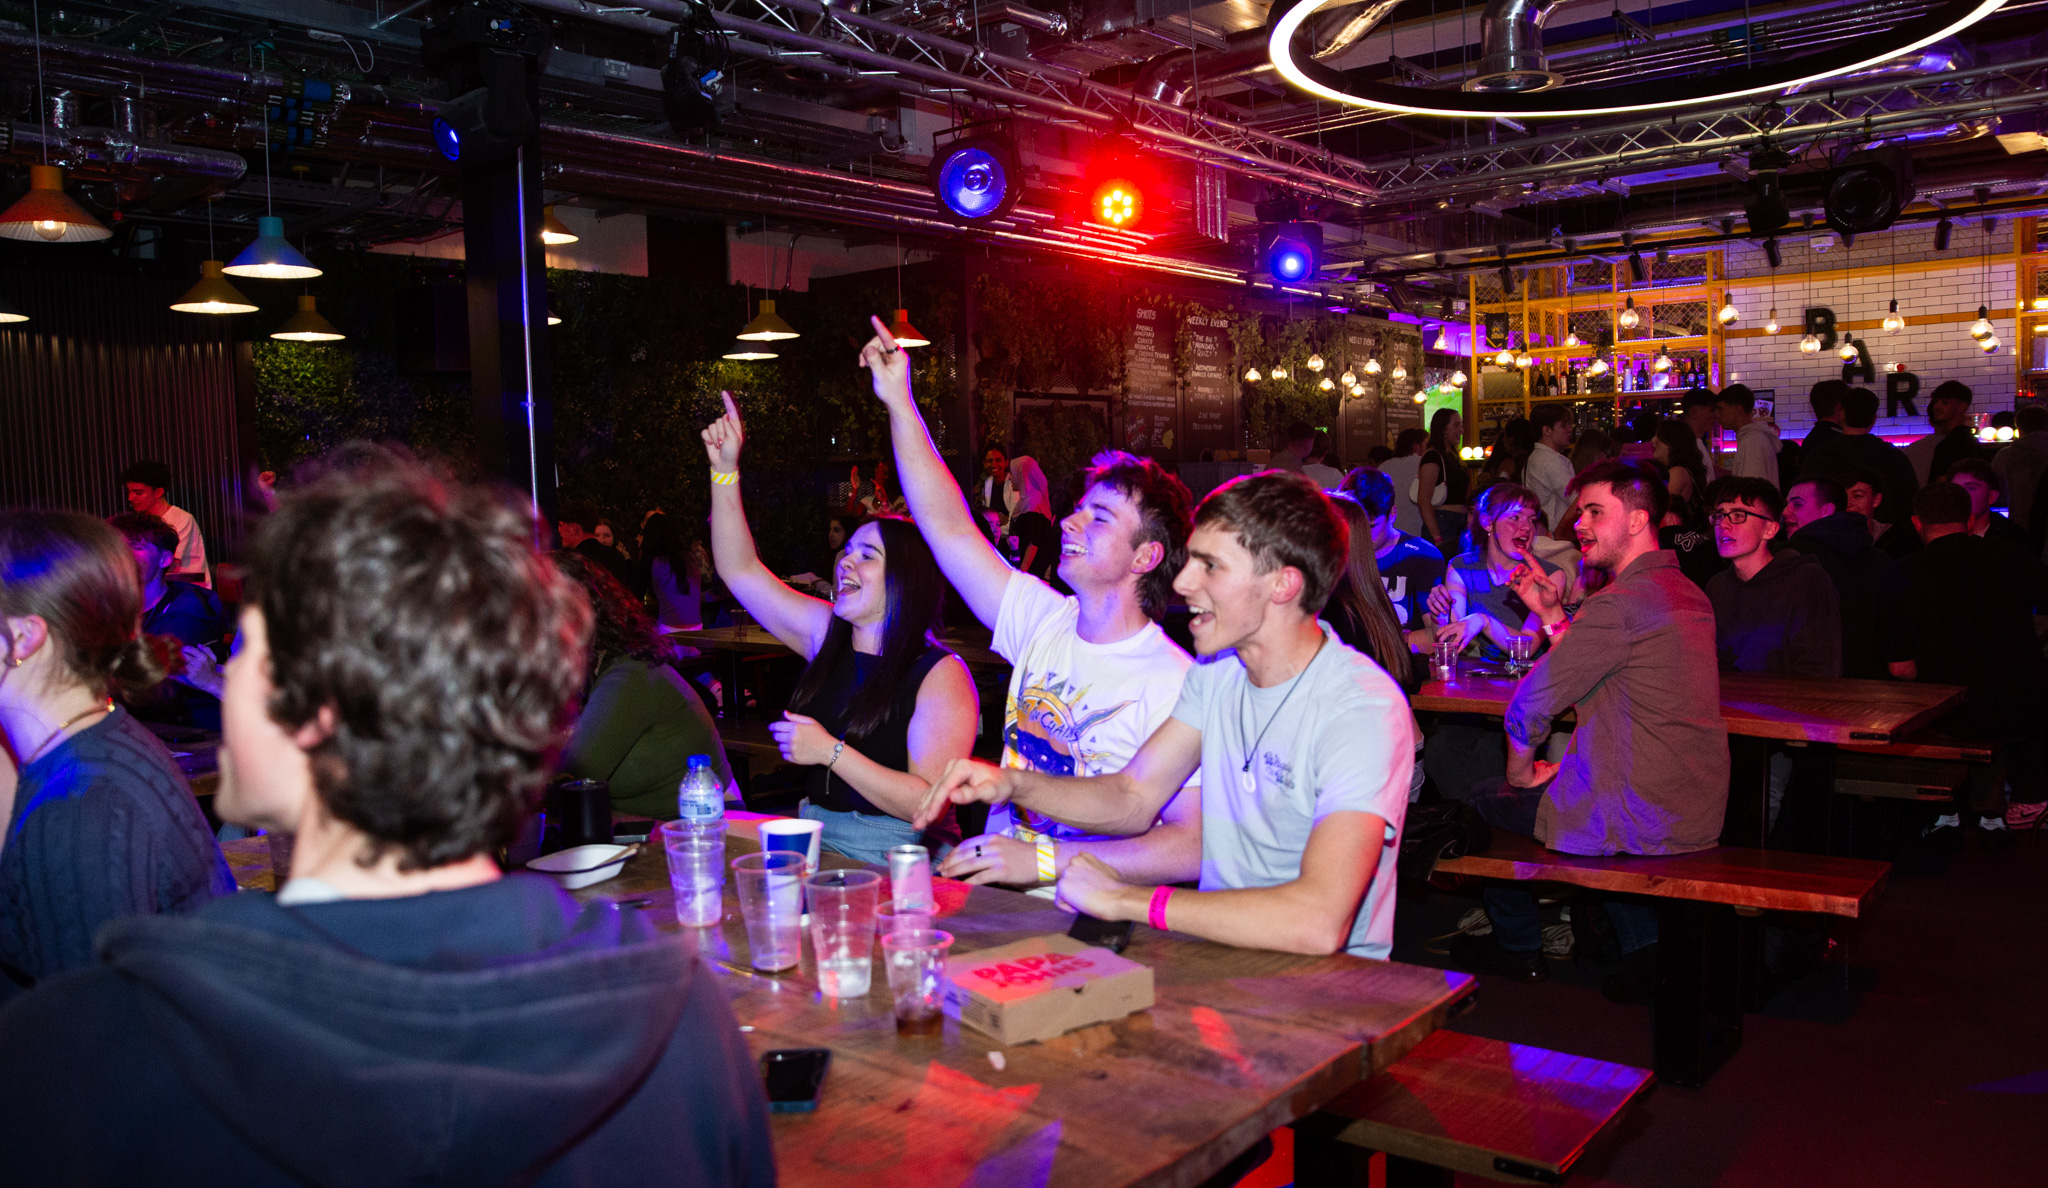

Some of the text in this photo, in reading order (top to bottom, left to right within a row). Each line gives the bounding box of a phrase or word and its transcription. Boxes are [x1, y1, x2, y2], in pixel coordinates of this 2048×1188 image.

[1136, 307, 1156, 320] SHOTS
[1187, 315, 1229, 328] WEEKLY EVENTS
[972, 953, 1077, 979] PAPA
